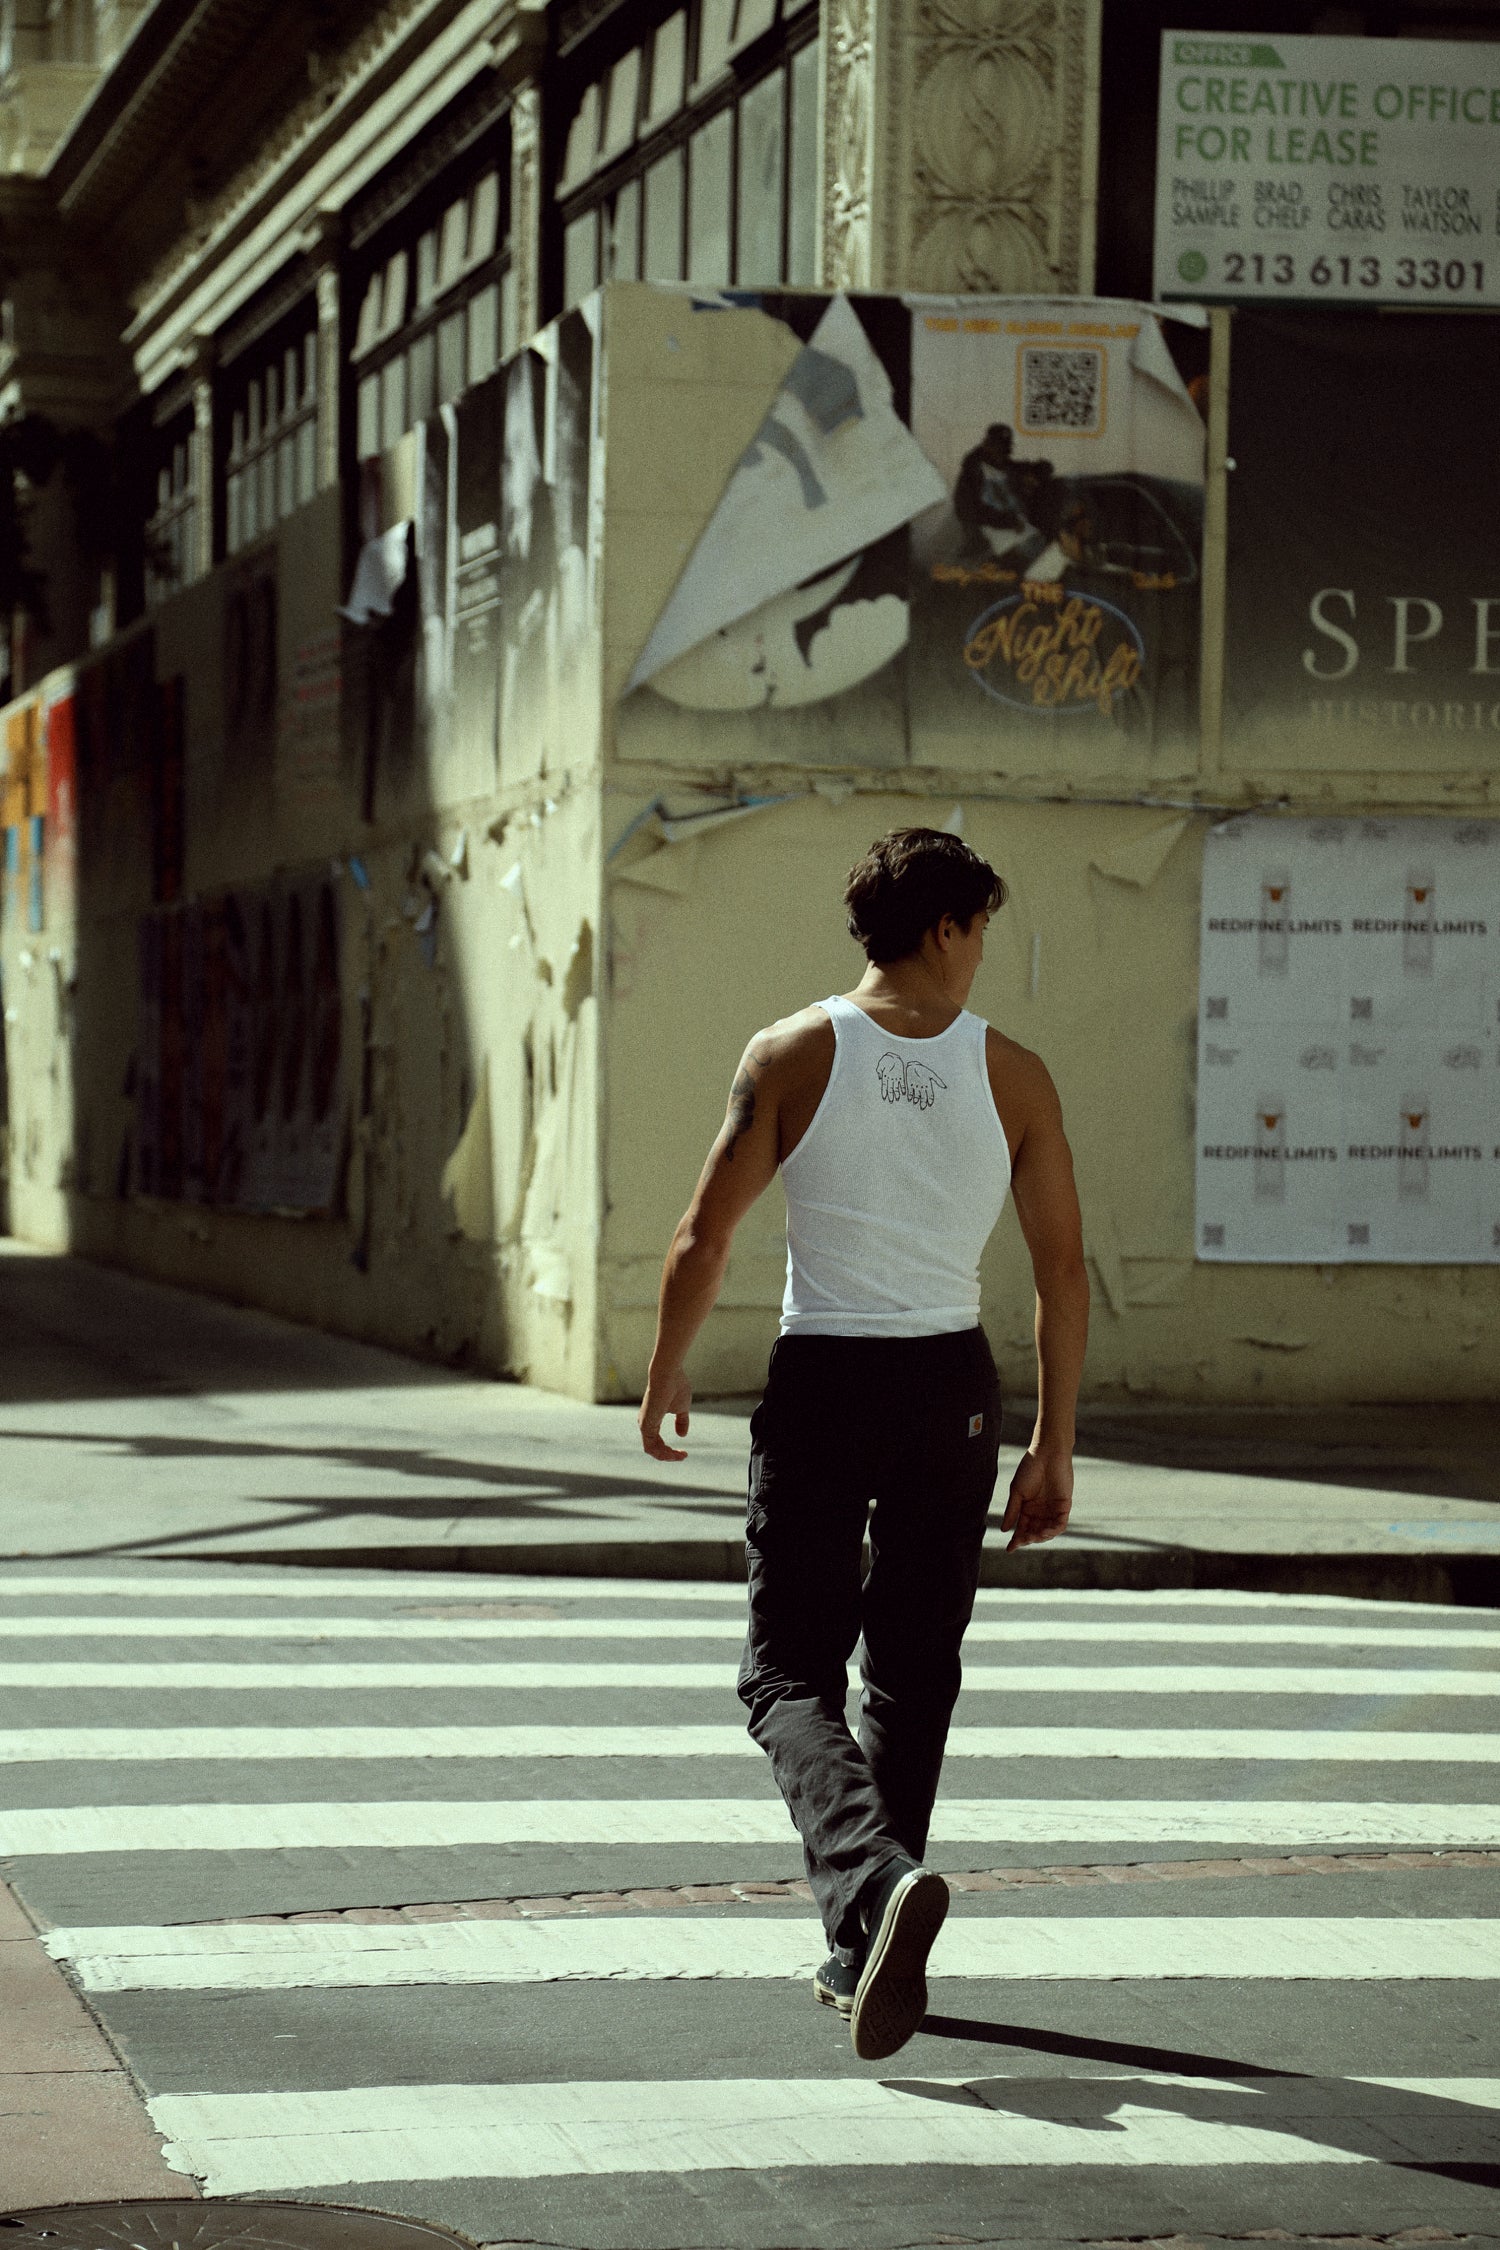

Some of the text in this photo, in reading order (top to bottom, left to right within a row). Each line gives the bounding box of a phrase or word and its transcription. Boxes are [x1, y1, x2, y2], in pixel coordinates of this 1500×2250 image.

[1176, 75, 1500, 124] CREATIVE OFFICE
[1174, 124, 1379, 166] FOR LEASE
[1254, 179, 1302, 202] BRAD
[1327, 182, 1382, 208] CHRIS
[1402, 185, 1470, 211] TAYLOR
[1172, 202, 1240, 229] SAMPLE
[1402, 209, 1482, 236] WATSON
[1224, 252, 1484, 291] 213 613 3301
[1288, 920, 1342, 934] LIMITS
[1433, 920, 1487, 935] LIMITS
[1283, 1147, 1338, 1162] LIMITS
[1428, 1146, 1482, 1161] LIMITS
